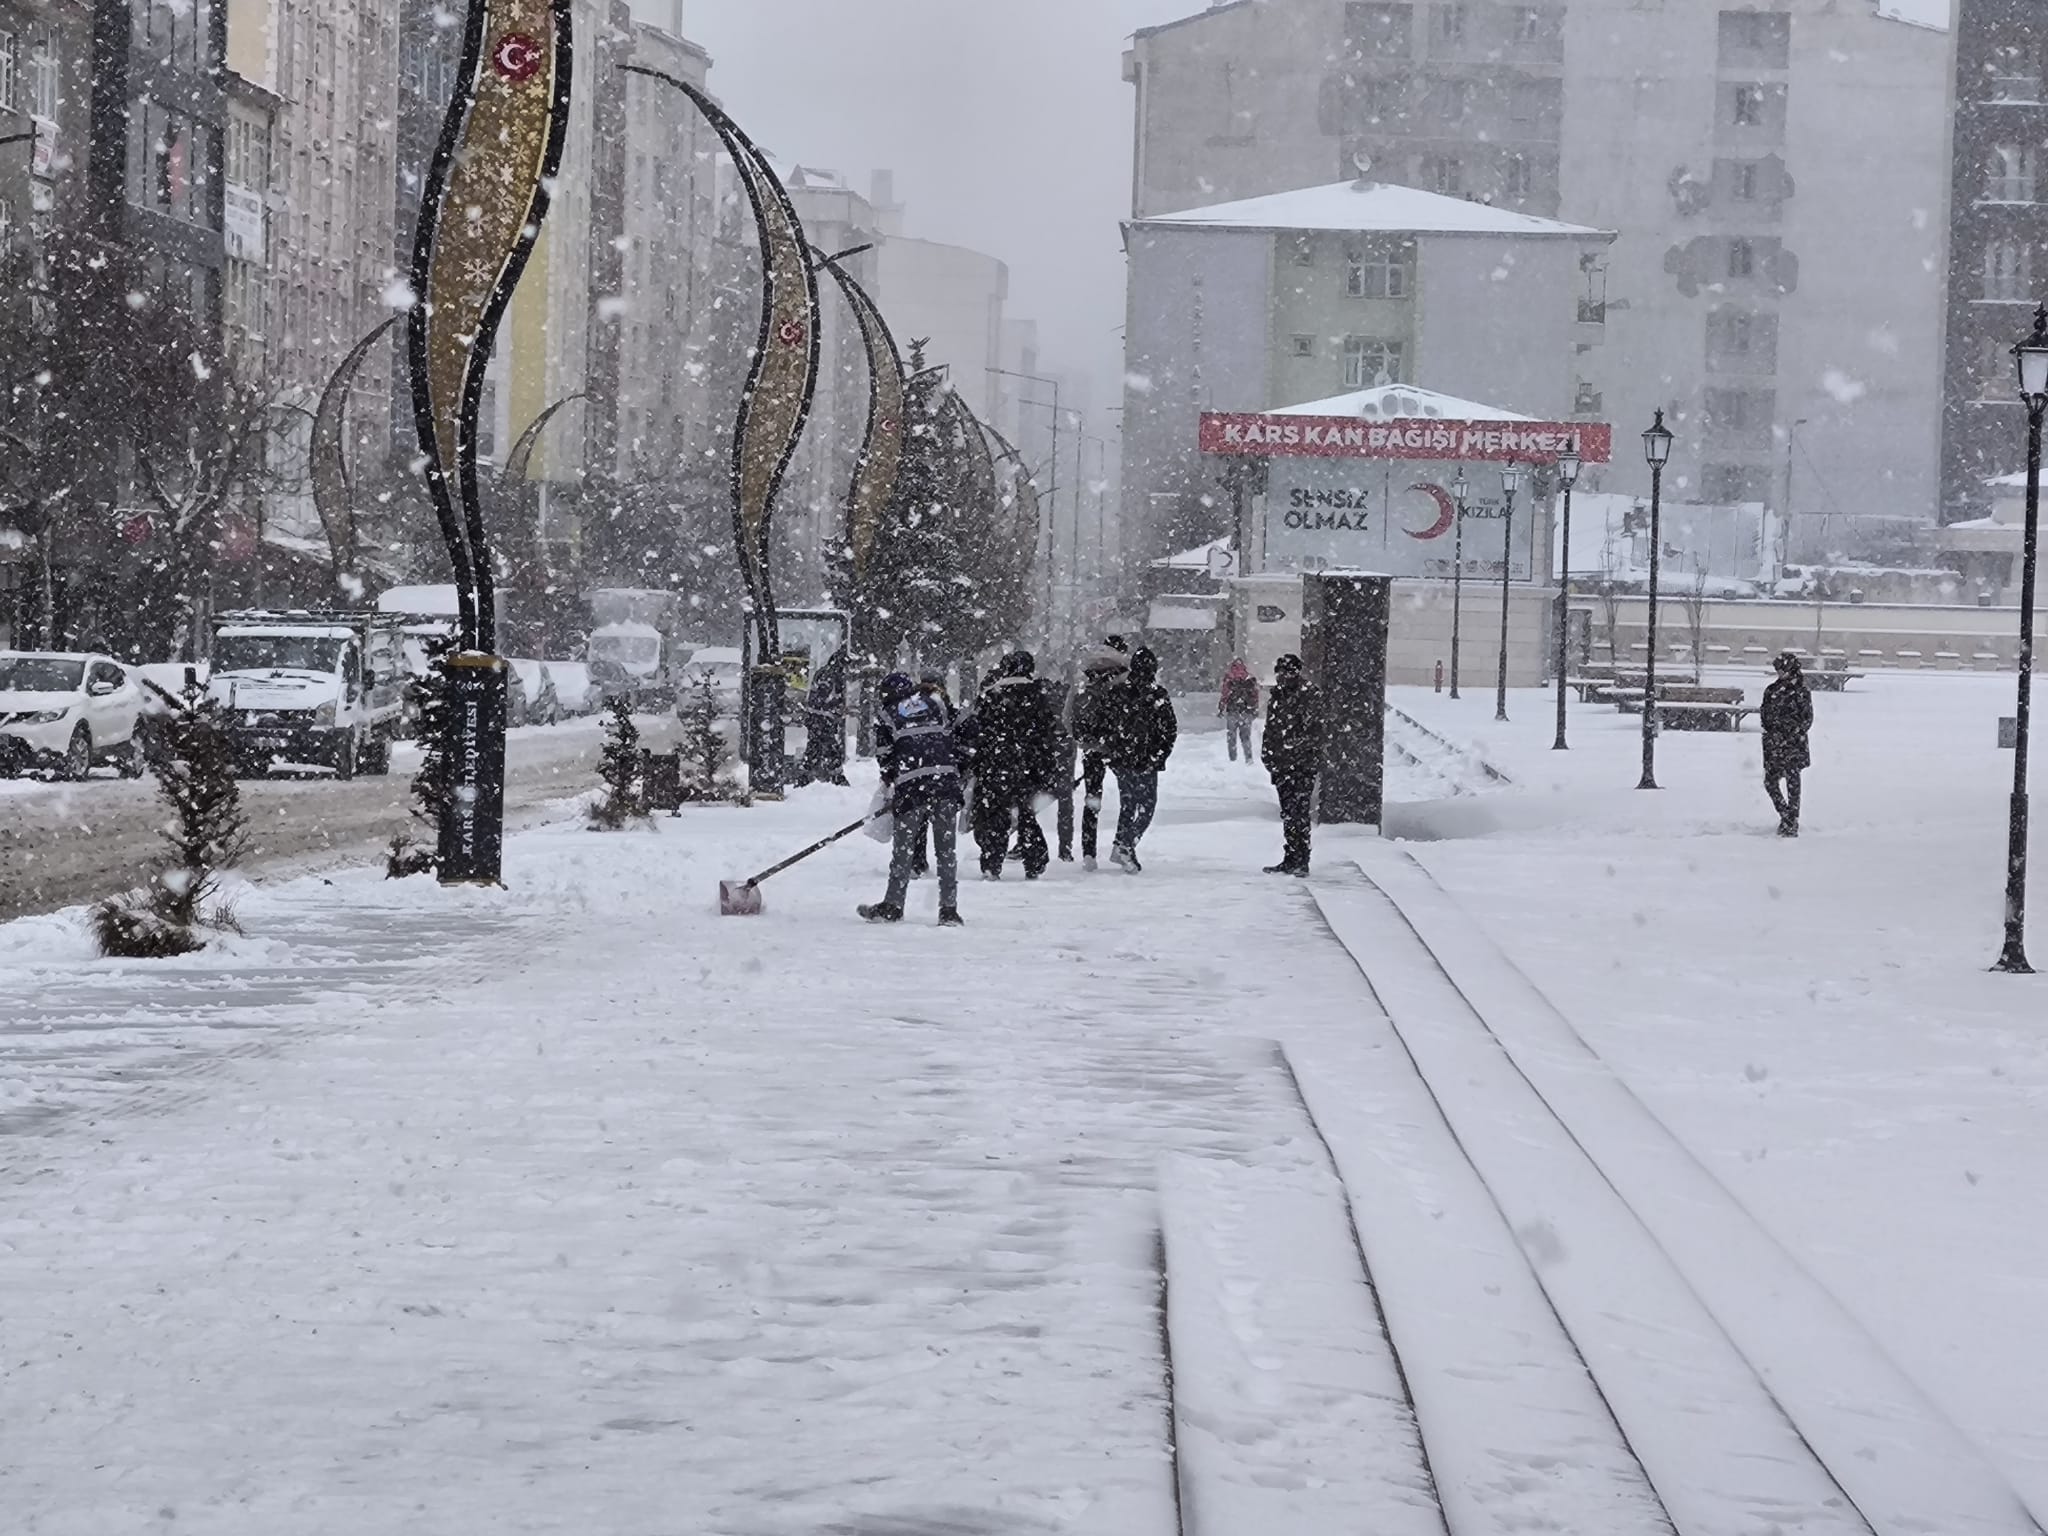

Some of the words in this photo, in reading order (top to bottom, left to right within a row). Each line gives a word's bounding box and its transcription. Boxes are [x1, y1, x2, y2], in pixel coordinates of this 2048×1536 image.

[1224, 423, 1300, 445] KARS
[1304, 426, 1365, 447] KAN
[1368, 421, 1457, 450] BAĞIŞI
[1461, 428, 1581, 452] MERKEZİ
[1283, 510, 1369, 531] OLMAZ
[461, 808, 474, 858] KARS
